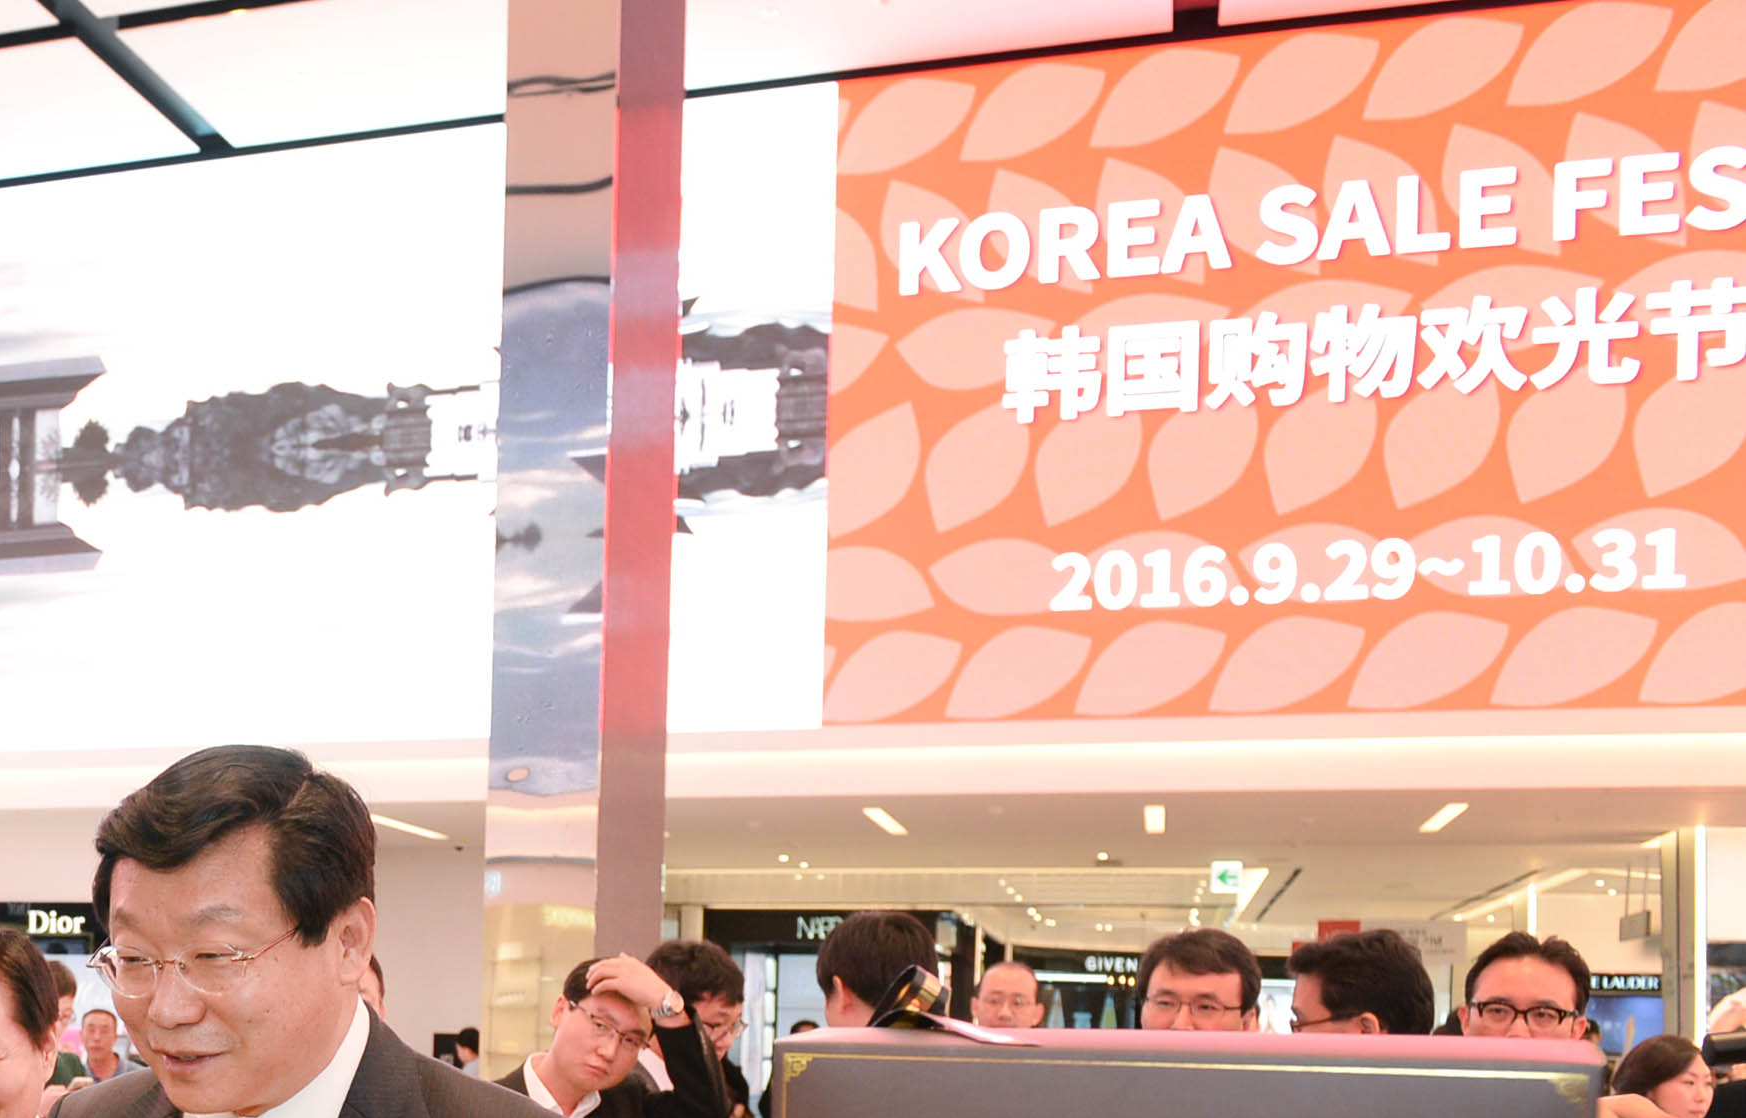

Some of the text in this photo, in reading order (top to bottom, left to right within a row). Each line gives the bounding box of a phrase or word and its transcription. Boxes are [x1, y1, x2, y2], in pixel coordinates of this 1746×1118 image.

[899, 146, 1746, 296] KOREA SALE FES
[1002, 277, 1746, 424] 韩国购物欢光节
[1050, 527, 1687, 611] 2016.9.29~10.31
[27, 909, 86, 934] Dior
